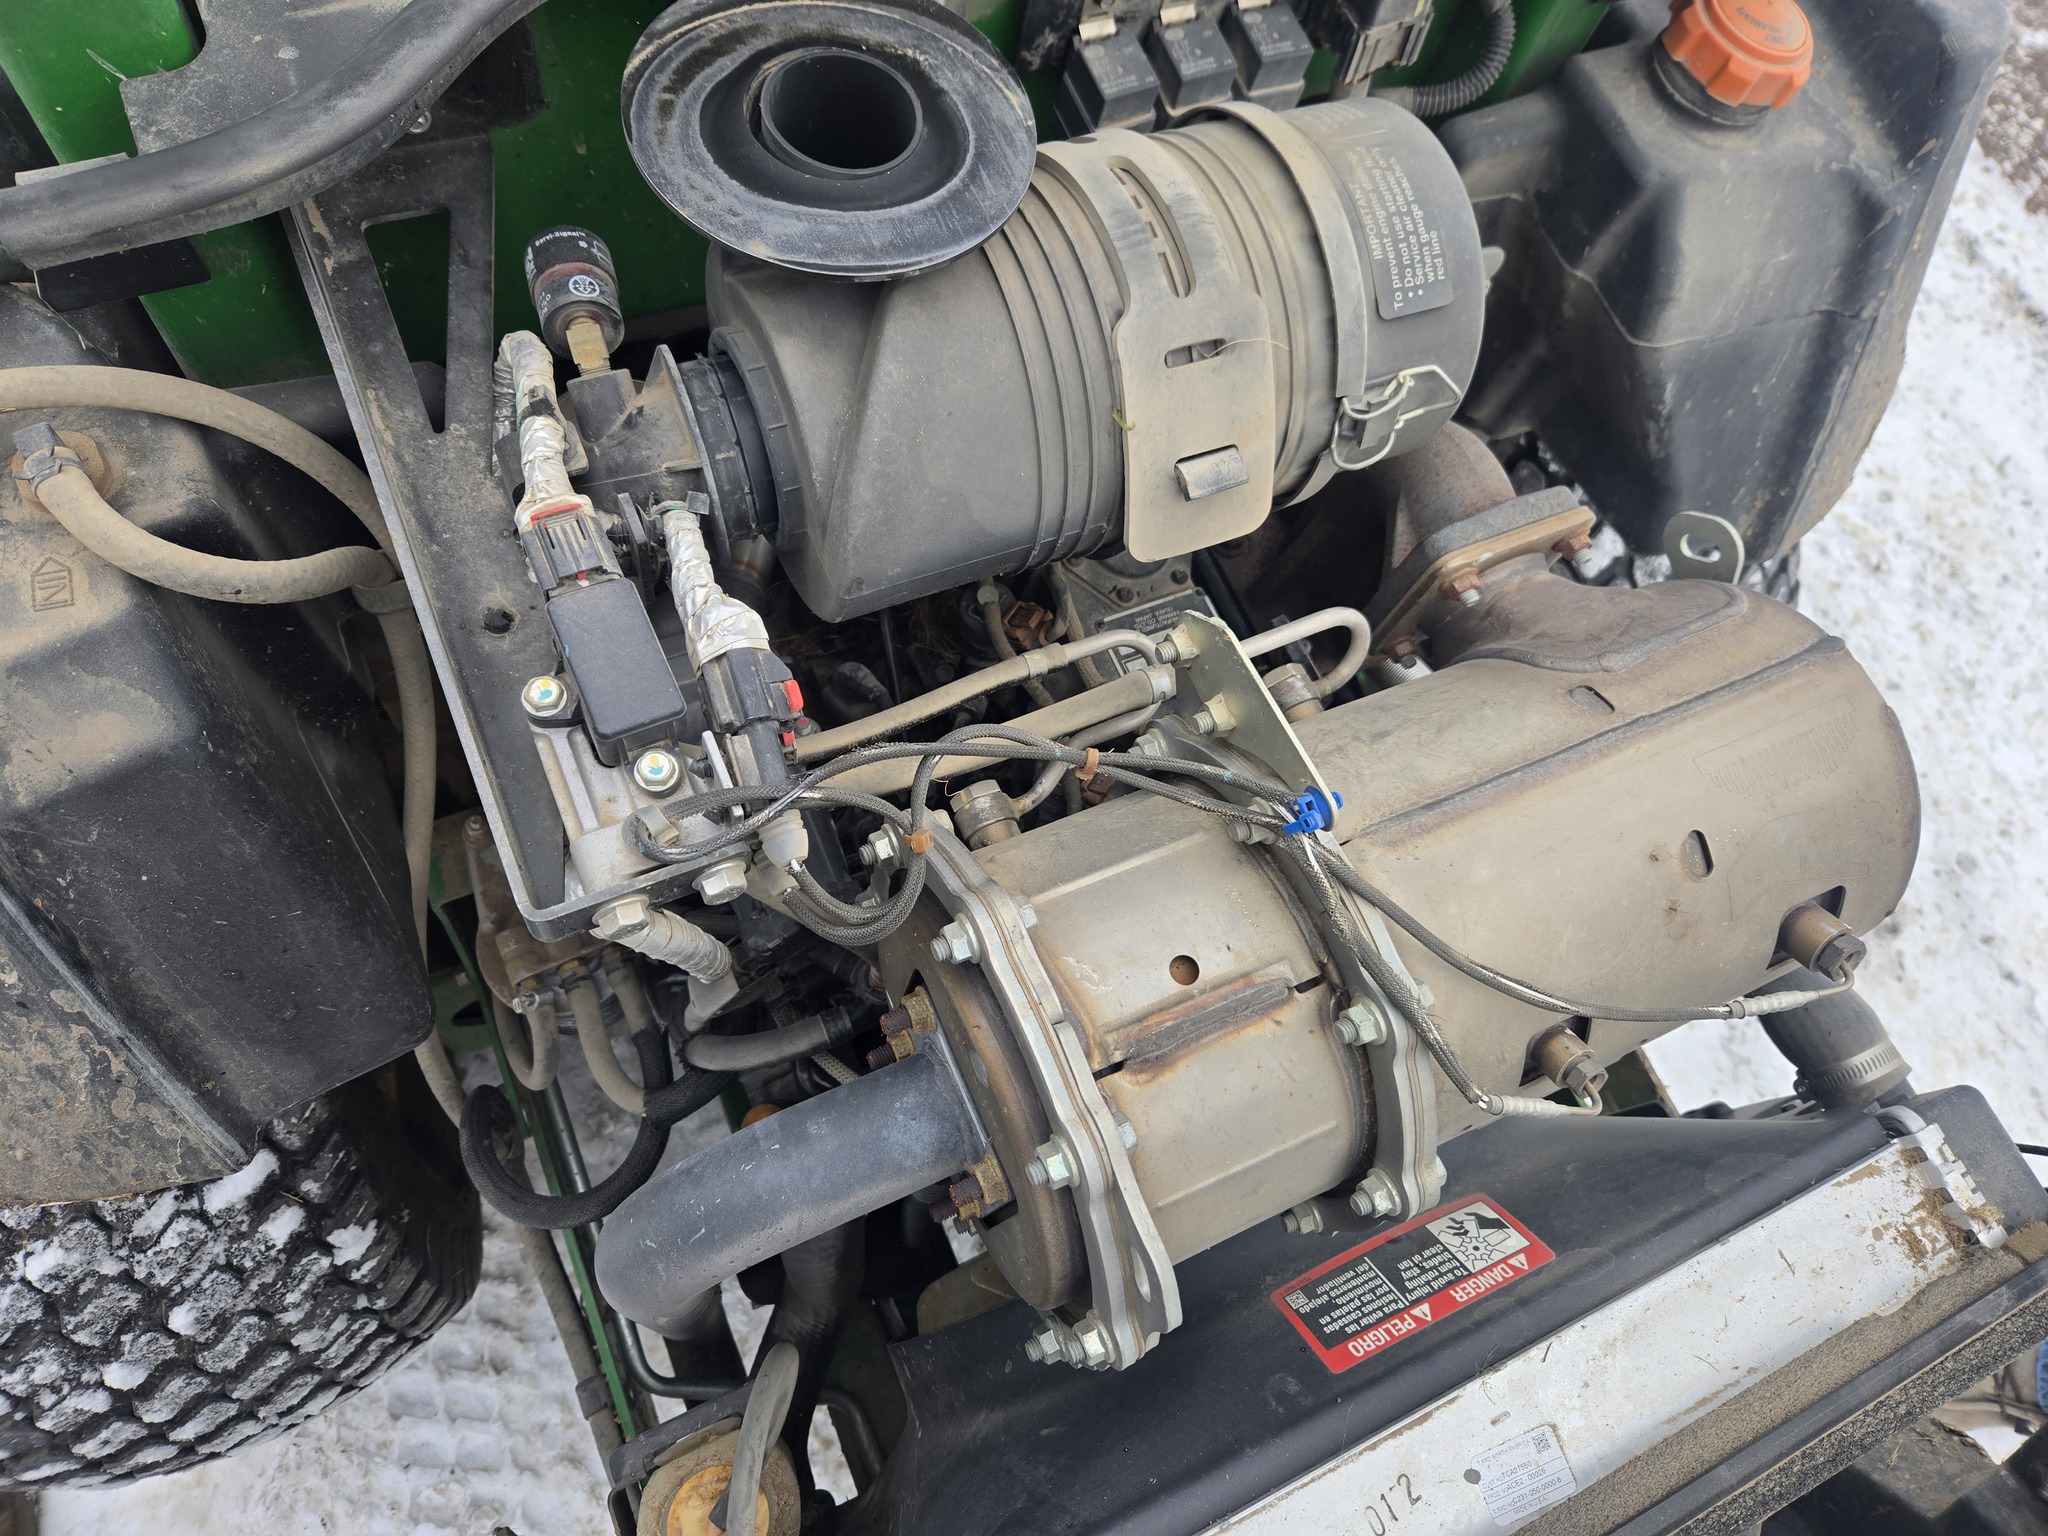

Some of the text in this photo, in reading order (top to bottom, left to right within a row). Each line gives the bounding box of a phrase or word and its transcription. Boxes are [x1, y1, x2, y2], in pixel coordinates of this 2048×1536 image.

[1372, 169, 1396, 213] starting
[1384, 170, 1407, 212] cleaner
[1349, 183, 1383, 260] IMPORTANT
[1369, 193, 1389, 235] engine
[1390, 157, 1435, 283] when gauge reaches
[1392, 216, 1404, 239] use
[1403, 216, 1414, 232] air
[1383, 237, 1402, 288] prevent
[1398, 242, 1411, 264] not
[1409, 234, 1424, 285] Service
[1430, 230, 1446, 280] red line
[1404, 268, 1414, 287] Do
[1393, 291, 1404, 311] To
[1397, 1243, 1443, 1269] clear of fan
[1400, 1250, 1452, 1279] blades, stay
[1404, 1258, 1459, 1290] from rotating
[1298, 1270, 1376, 1314] mantenerse alejado
[1315, 1262, 1370, 1294] del ventilador
[1331, 1277, 1382, 1306] movimiento,
[1405, 1265, 1468, 1301] To avoid injury
[1448, 1262, 1514, 1303] DANGER
[1318, 1283, 1389, 1324] por las paletas en
[1323, 1292, 1397, 1334] lesiones causadas
[1344, 1299, 1404, 1334] Para evitar las
[1346, 1313, 1416, 1358] PELIGRO
